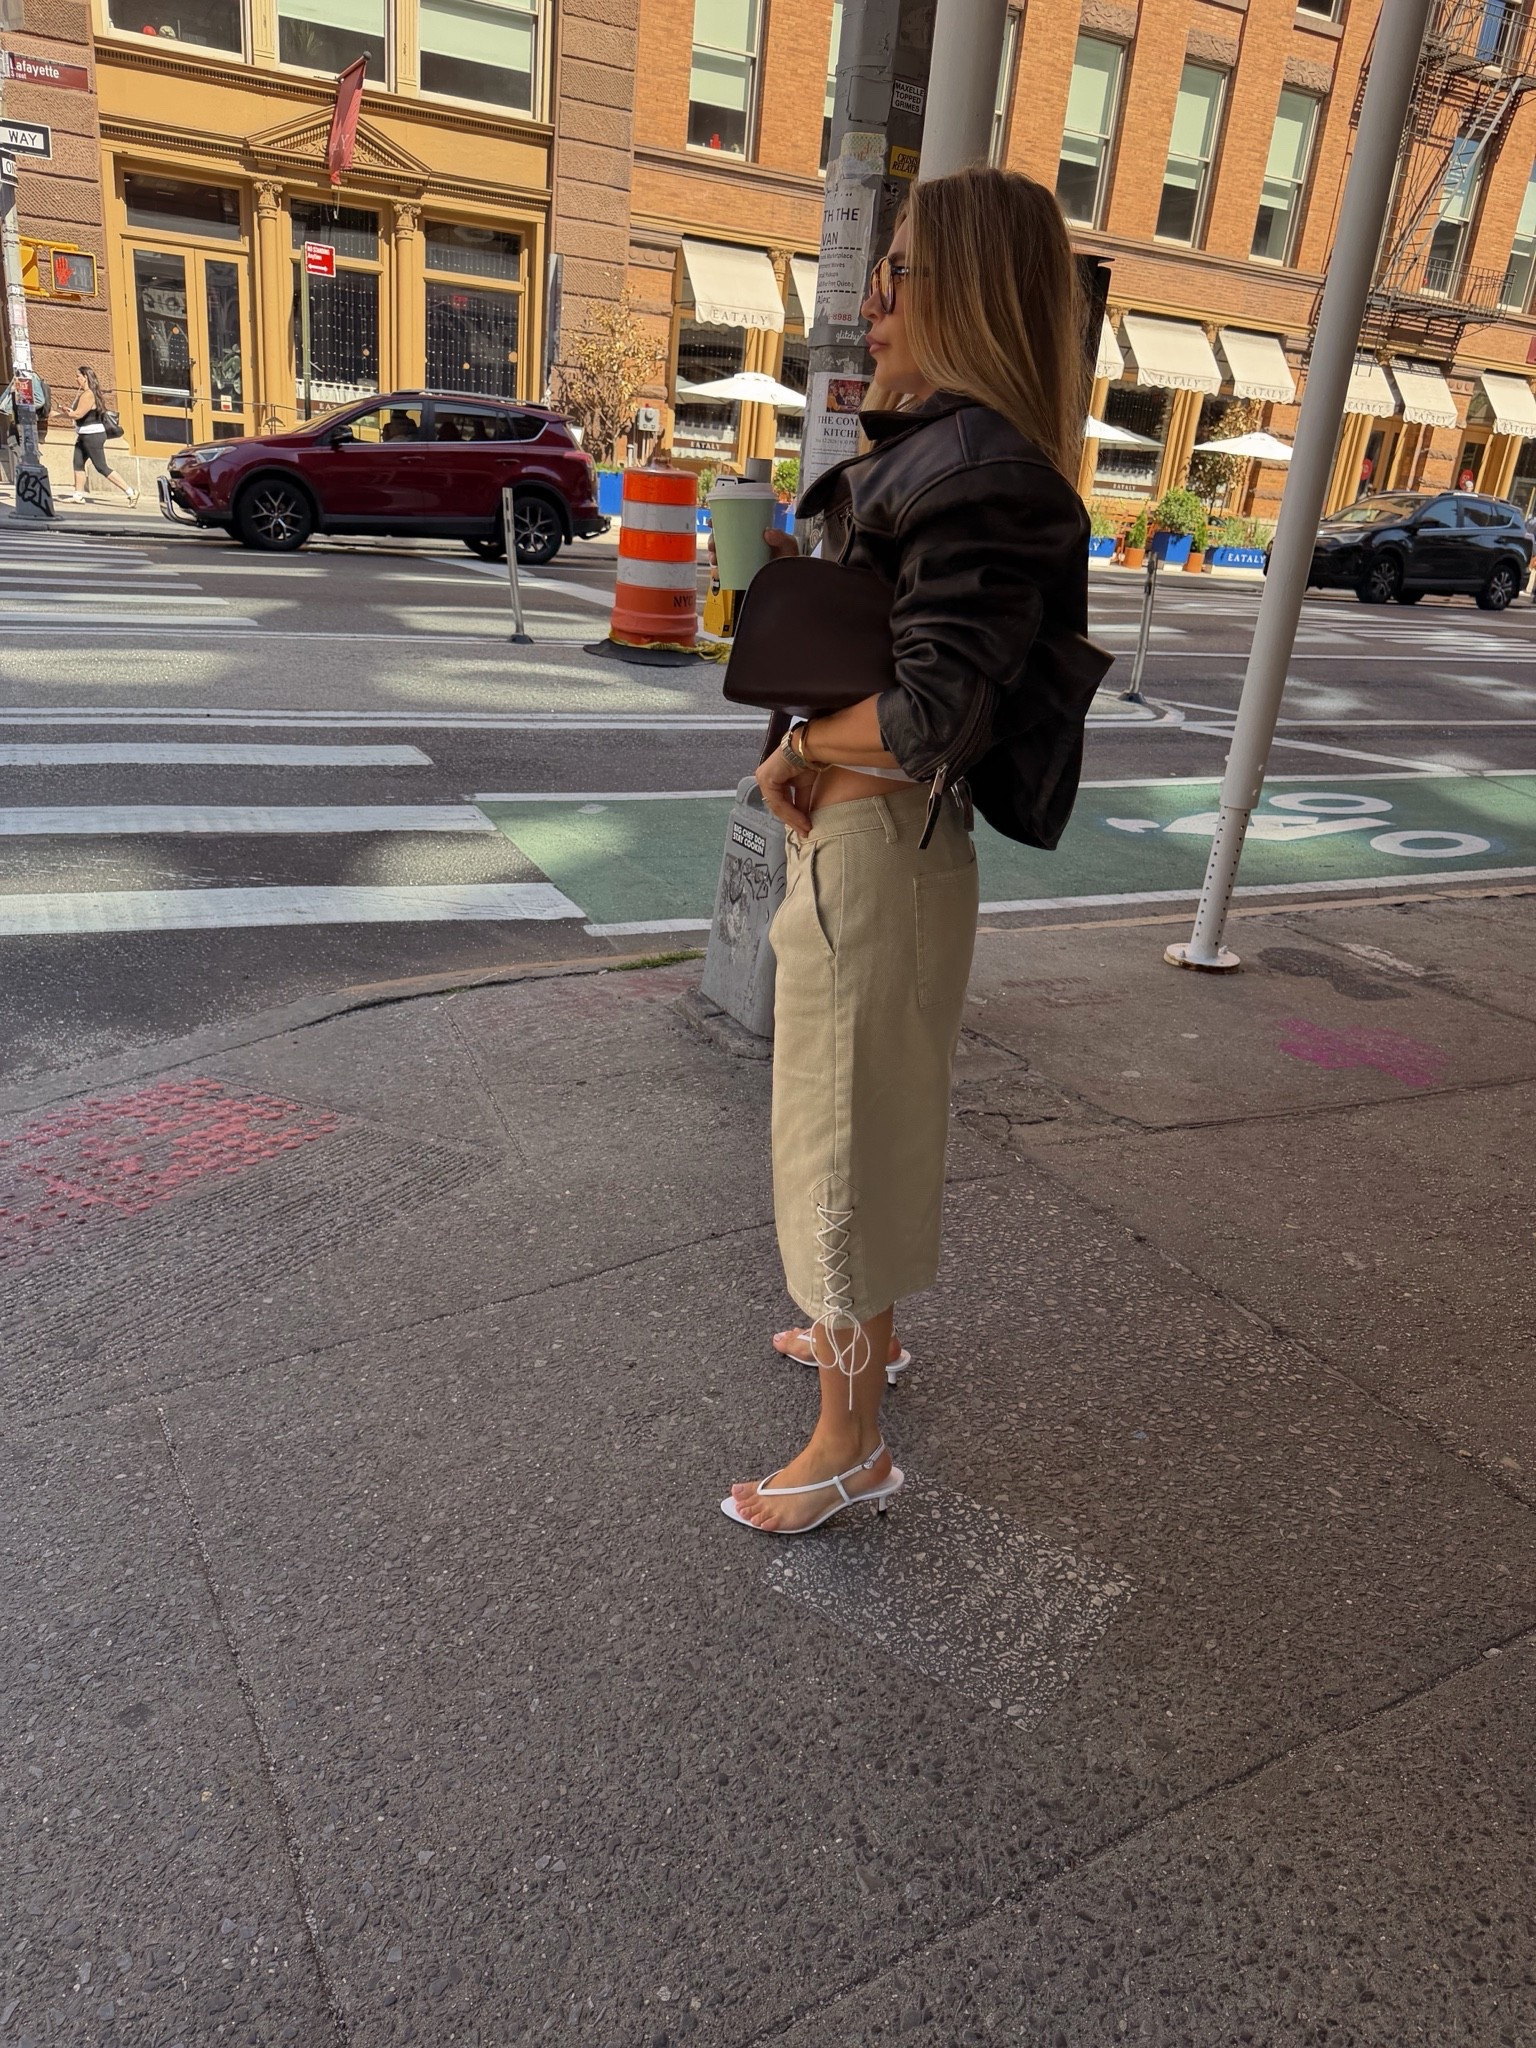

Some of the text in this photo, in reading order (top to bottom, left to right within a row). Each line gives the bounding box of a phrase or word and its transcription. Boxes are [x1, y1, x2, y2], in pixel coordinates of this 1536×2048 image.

[9, 57, 60, 78] Lafayette
[894, 82, 925, 97] MAXELLE
[895, 90, 921, 105] TOPPED
[894, 99, 920, 113] GRIMES
[8, 129, 37, 147] WAY
[823, 207, 860, 223] TH THE
[712, 309, 769, 326] EATALY
[1158, 376, 1201, 388] EATALY
[1245, 386, 1286, 399] EATALY
[1347, 402, 1384, 412] EATALY
[817, 415, 859, 426] THE COM
[1413, 410, 1448, 424] EATALY
[823, 428, 861, 439] KITCHE
[690, 440, 722, 450] EATALY
[1227, 553, 1267, 564] EATALY
